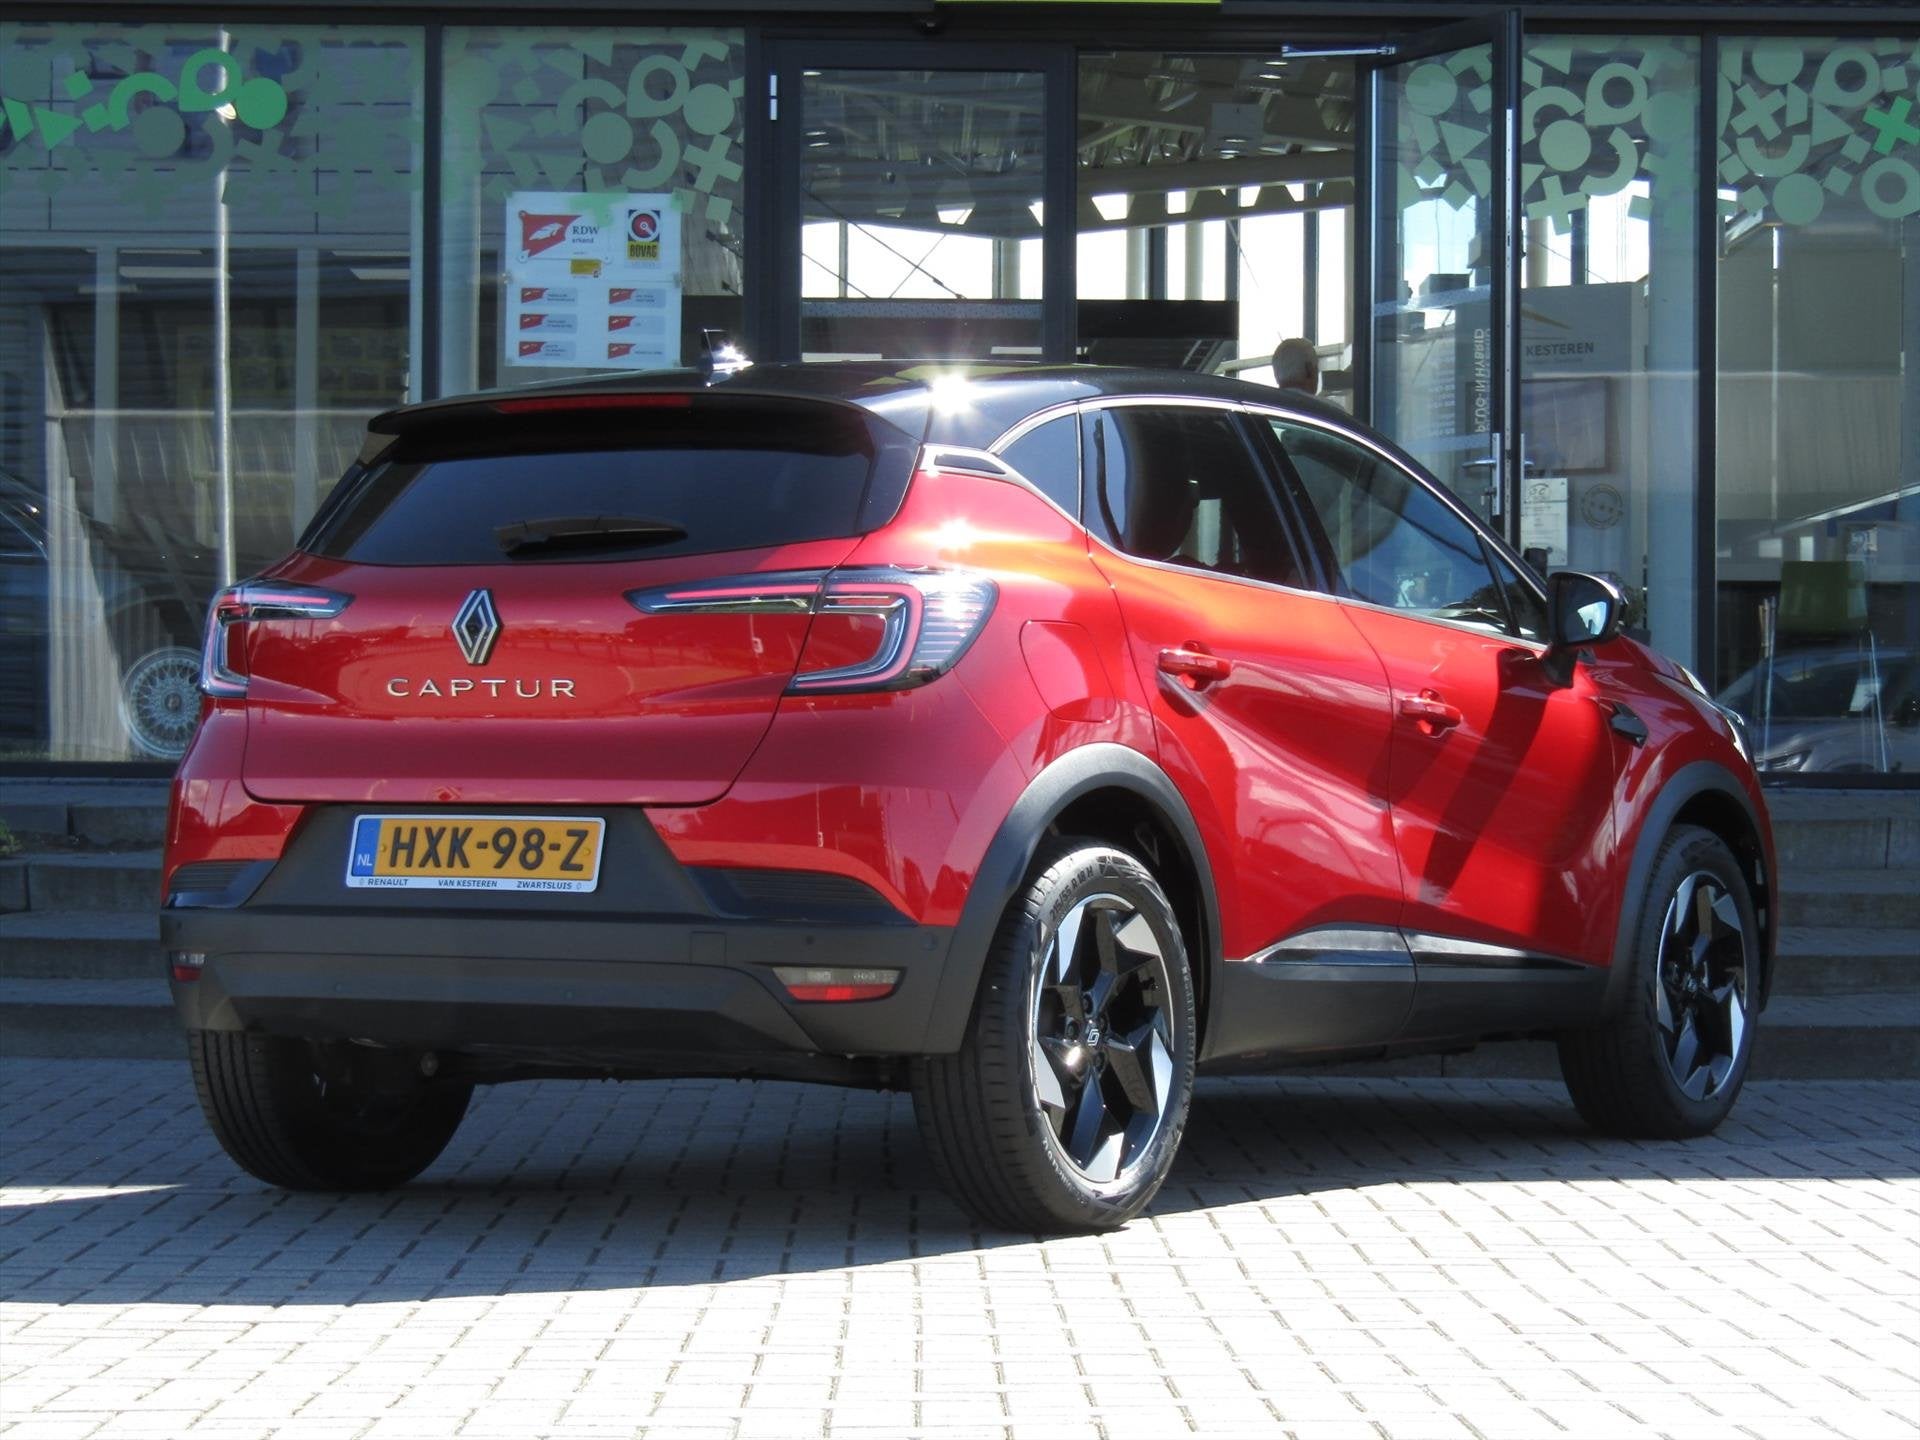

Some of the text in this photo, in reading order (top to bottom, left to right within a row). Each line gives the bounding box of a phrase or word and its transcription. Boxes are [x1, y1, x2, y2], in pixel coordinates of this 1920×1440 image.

[572, 225, 600, 235] RDW
[629, 244, 657, 259] BOVAG
[1526, 342, 1594, 356] KESTEREN
[387, 678, 576, 698] CAPTUR
[388, 826, 589, 872] HXK-98-Z
[356, 853, 373, 867] NL
[367, 877, 572, 891] RENAULT VAN KESTEREN ZWARTSLUIS
